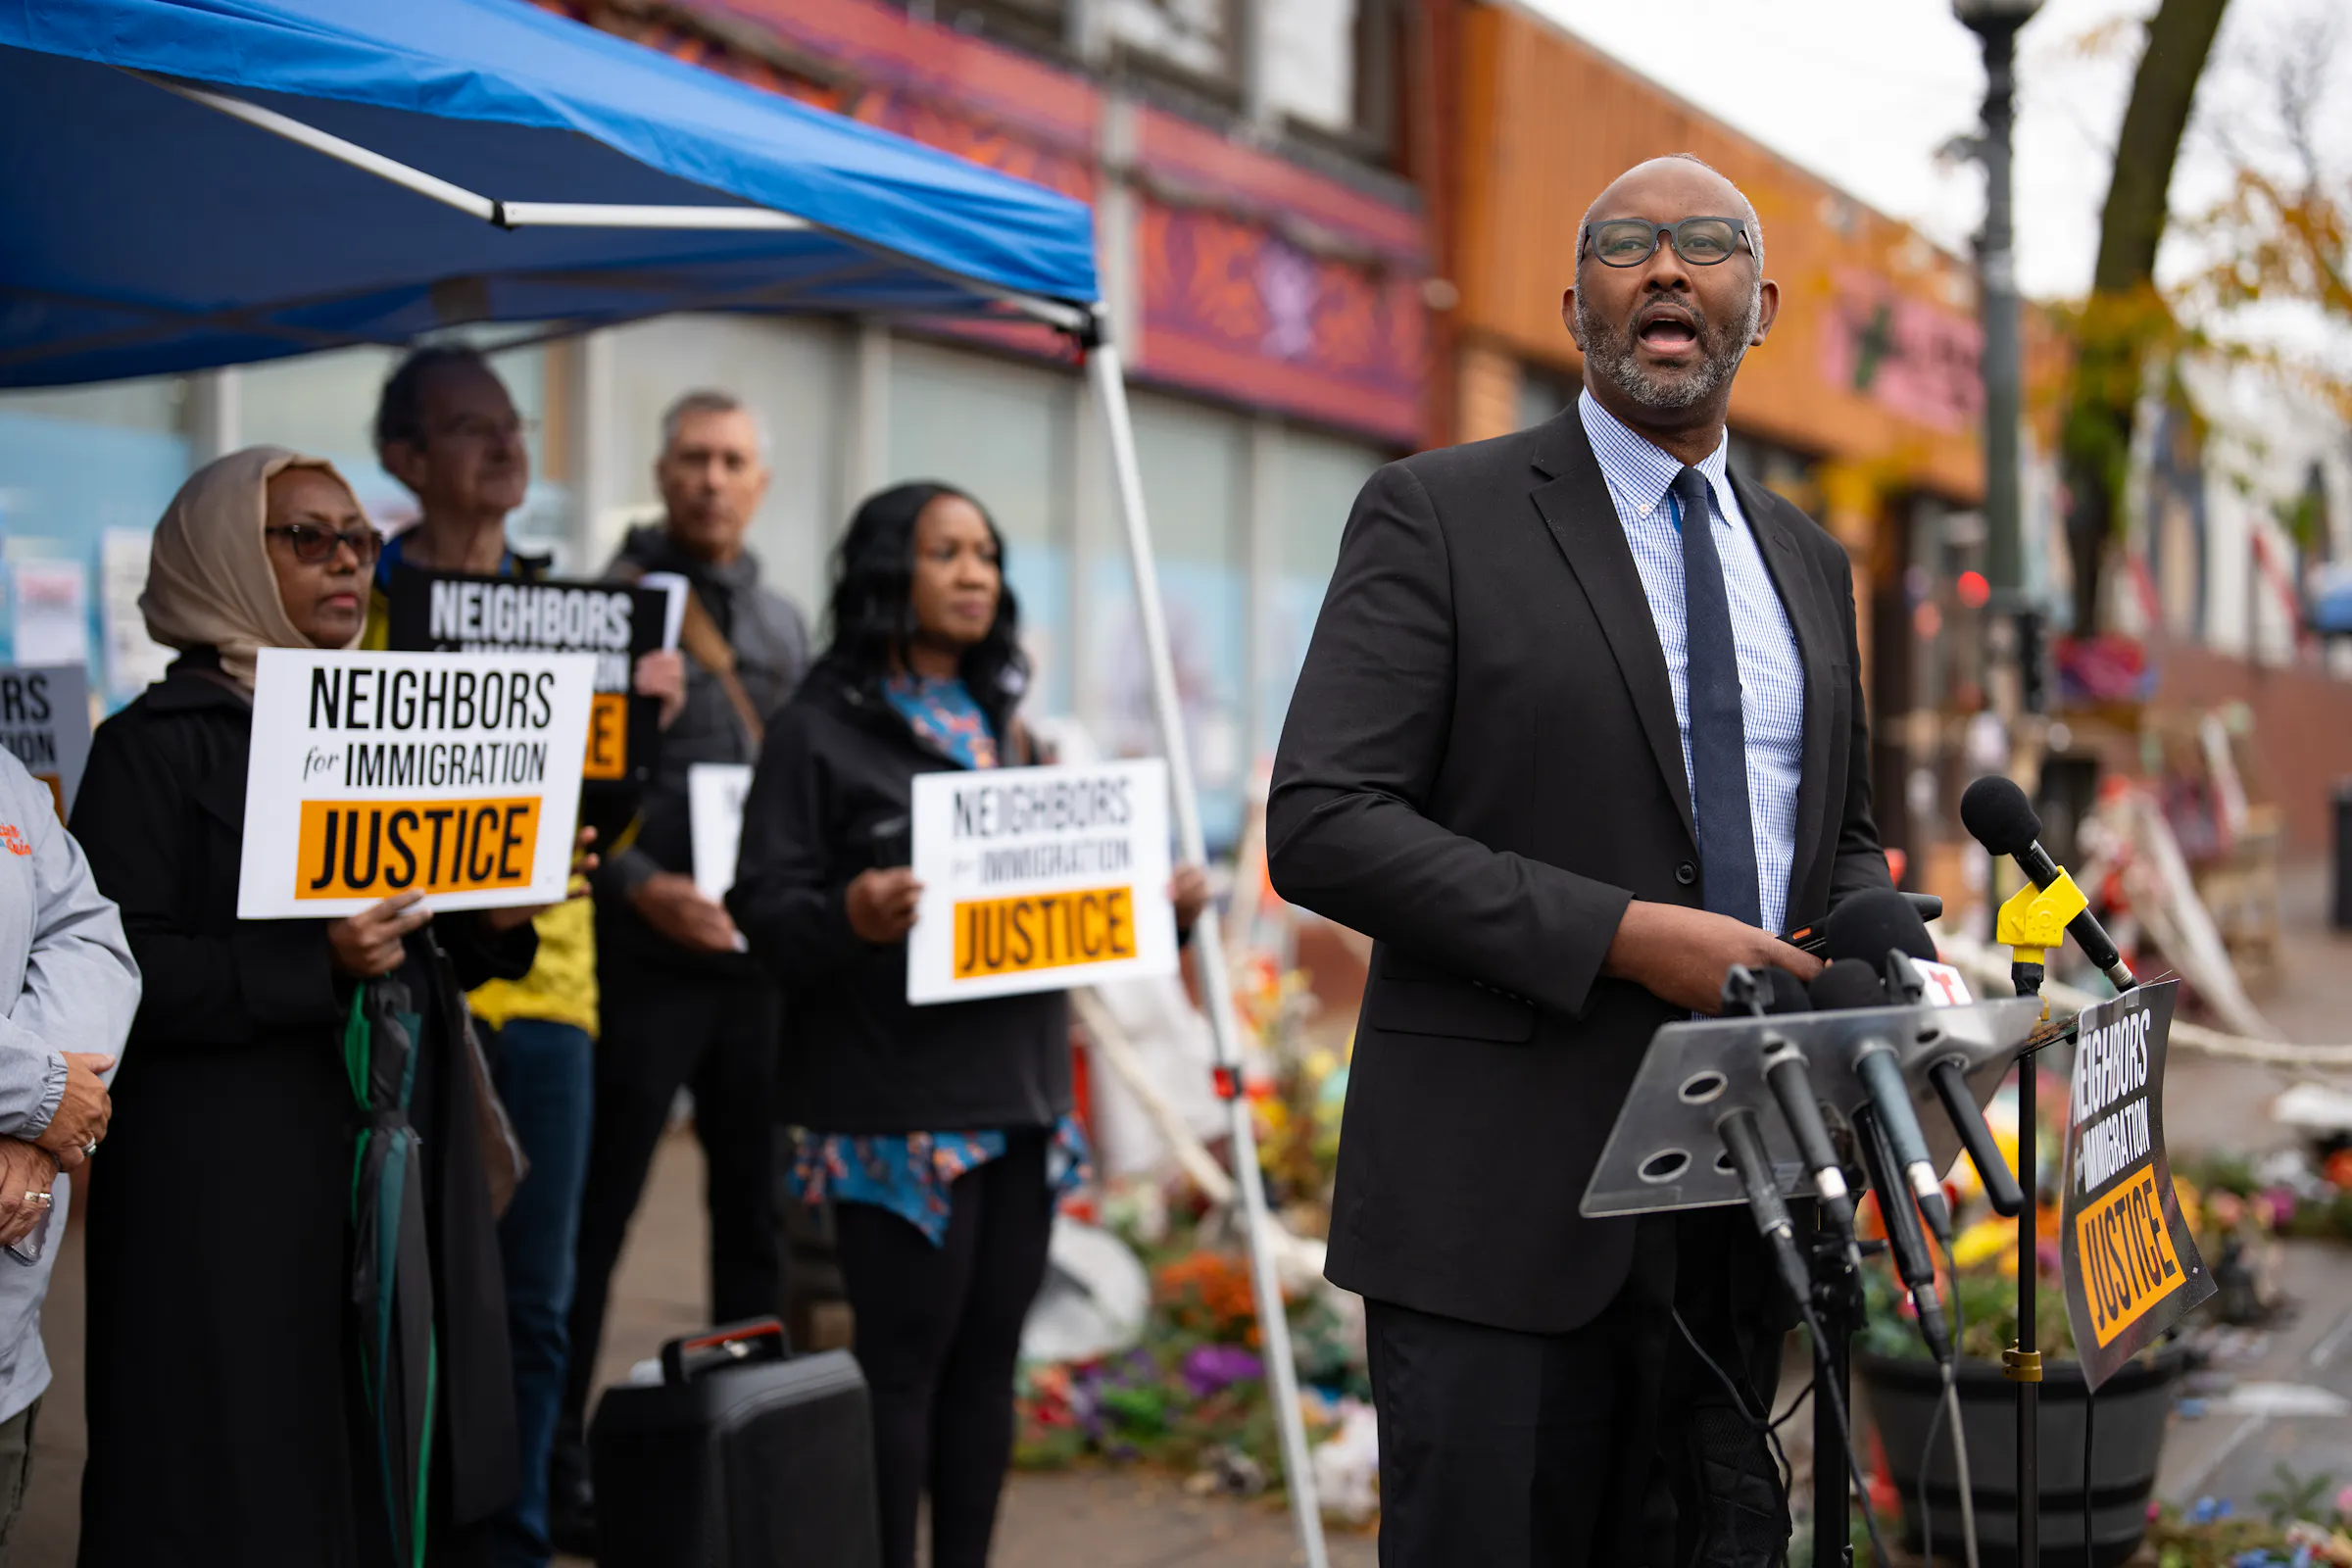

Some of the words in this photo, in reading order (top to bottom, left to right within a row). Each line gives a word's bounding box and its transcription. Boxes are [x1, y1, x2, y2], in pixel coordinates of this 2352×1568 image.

[429, 579, 634, 650] NEIGHBORS
[309, 666, 556, 730] NEIGHBORS
[303, 745, 340, 782] for
[345, 741, 548, 787] IMMIGRATION
[311, 805, 530, 890] JUSTICE
[961, 891, 1127, 972] JUSTICE
[2073, 1008, 2150, 1127] NEIGHBORS
[2082, 1096, 2150, 1194] IMMIGRATION
[2085, 1178, 2176, 1331] JUSTICE
